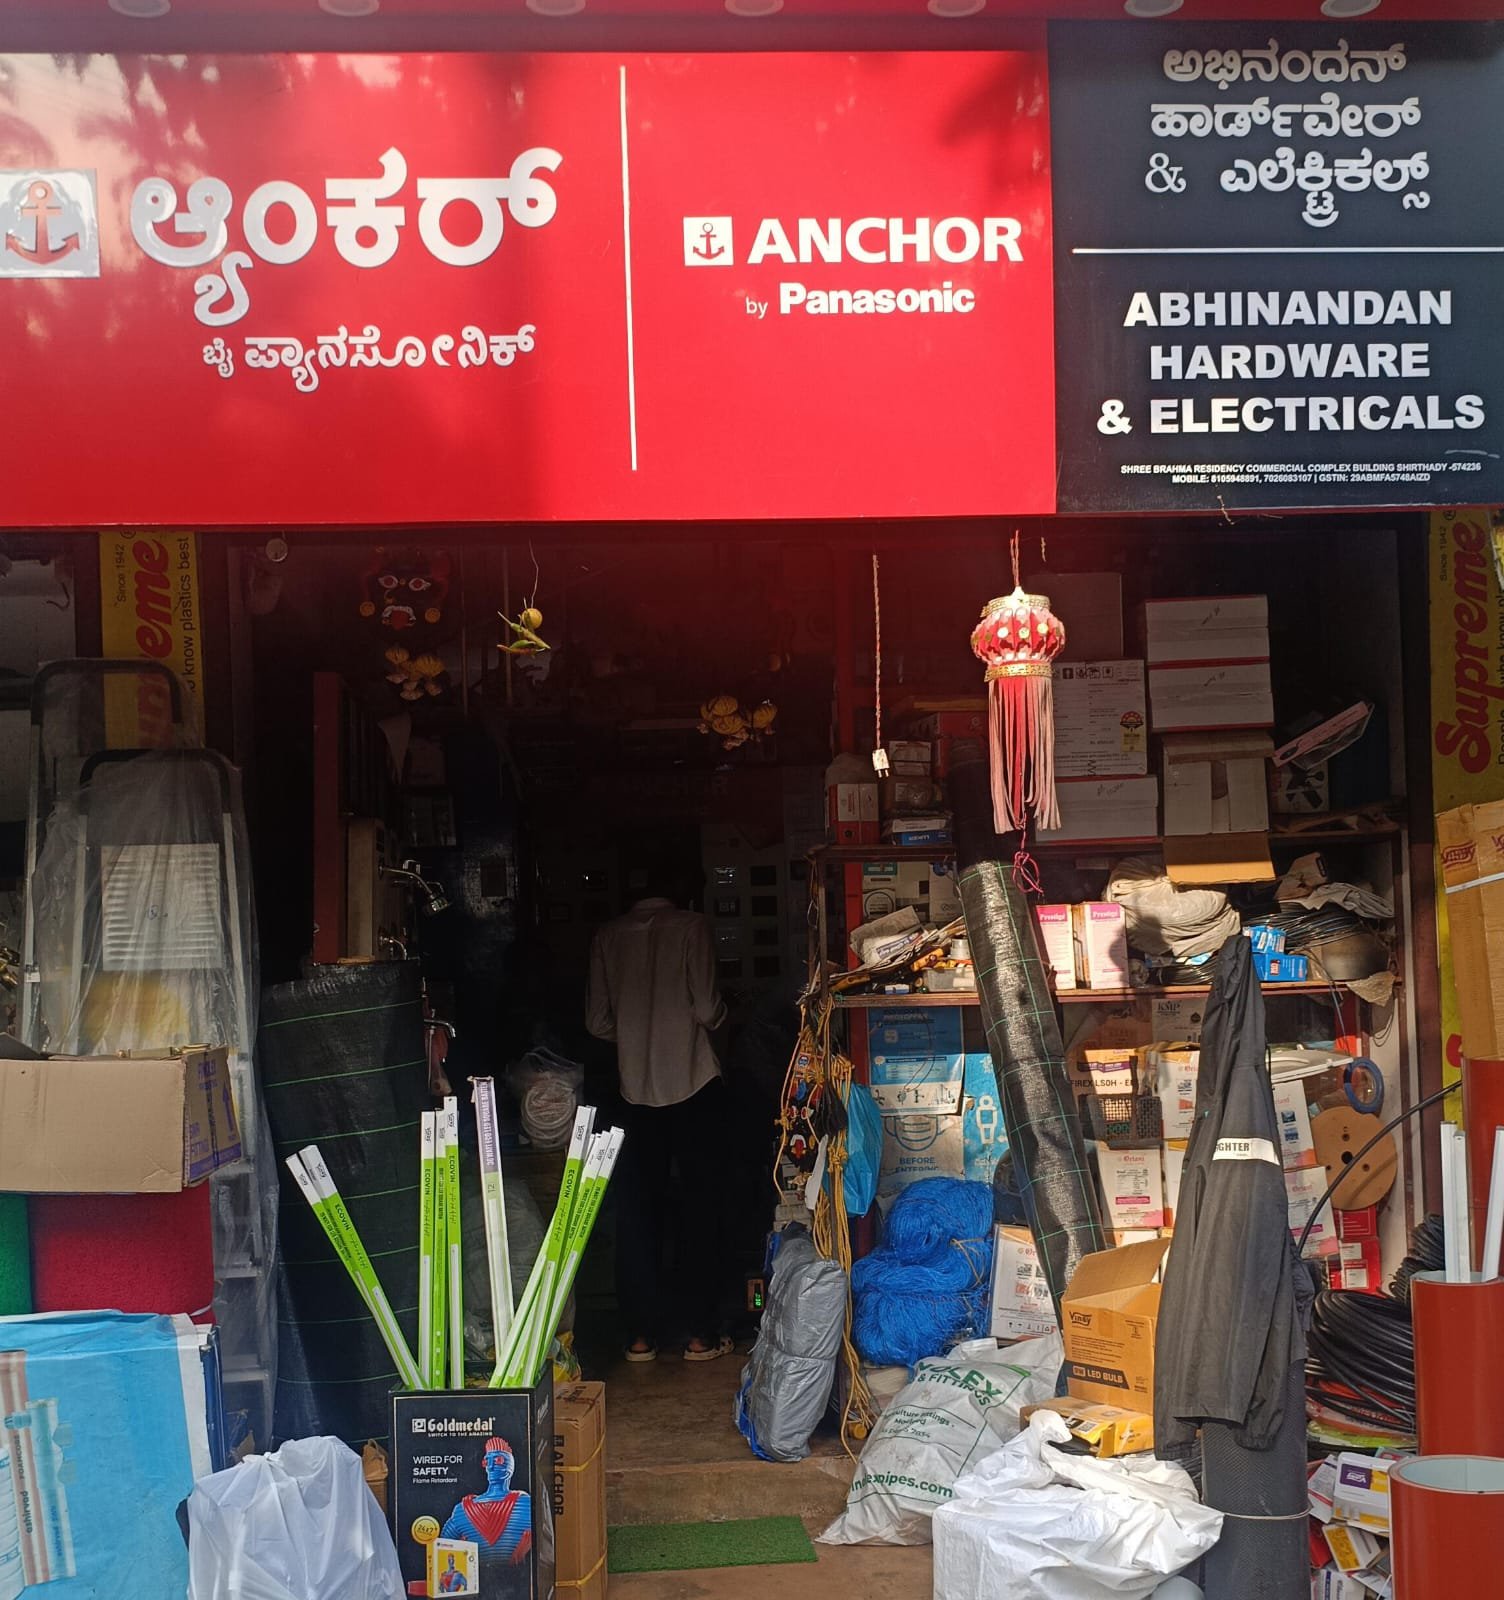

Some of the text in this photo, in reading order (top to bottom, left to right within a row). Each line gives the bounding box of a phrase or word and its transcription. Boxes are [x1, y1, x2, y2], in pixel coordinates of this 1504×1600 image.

[1163, 38, 1406, 90] ಅಭಿನಂದನ್
[1145, 147, 1431, 228] & ಎಲೆಕ್ಟ್ರಿಕಲ್ಸ್
[747, 216, 1024, 264] ANCHOR
[745, 281, 976, 319] by Panasonic
[1123, 289, 1452, 327] ABHINANDAN
[202, 337, 234, 378] ಬೈ
[1150, 343, 1430, 380] HARDWARE
[1097, 395, 1486, 435] & ELECTRICALS
[1120, 464, 1152, 474] SHREE
[1153, 464, 1193, 474] BRAHMA
[1194, 464, 1245, 473] RESIDENCY
[1246, 463, 1306, 473] COMMERCIAL
[1307, 463, 1351, 473] COMPLEX
[1352, 463, 1395, 473] BUILDING
[1396, 462, 1447, 472] SHIRTHADY
[1172, 474, 1210, 484] MOBILE:
[1319, 473, 1349, 483] GSTIN:
[177, 537, 190, 570] best
[1439, 554, 1448, 582] Since
[114, 543, 127, 603] Since 1942
[178, 574, 195, 632] plastics
[181, 635, 195, 676] know
[1435, 520, 1504, 775] Supreme
[899, 1156, 937, 1166] BEFORE
[563, 1169, 575, 1199] ECOVIN
[334, 1203, 351, 1232] ECOVIN
[1087, 1369, 1101, 1379] LED
[1102, 1372, 1124, 1384] BULB
[427, 1417, 493, 1432] Goldmedal
[412, 1455, 463, 1465] WIRED FOR
[412, 1467, 449, 1476] SAFETY
[20, 1490, 33, 1534] ashirvad
